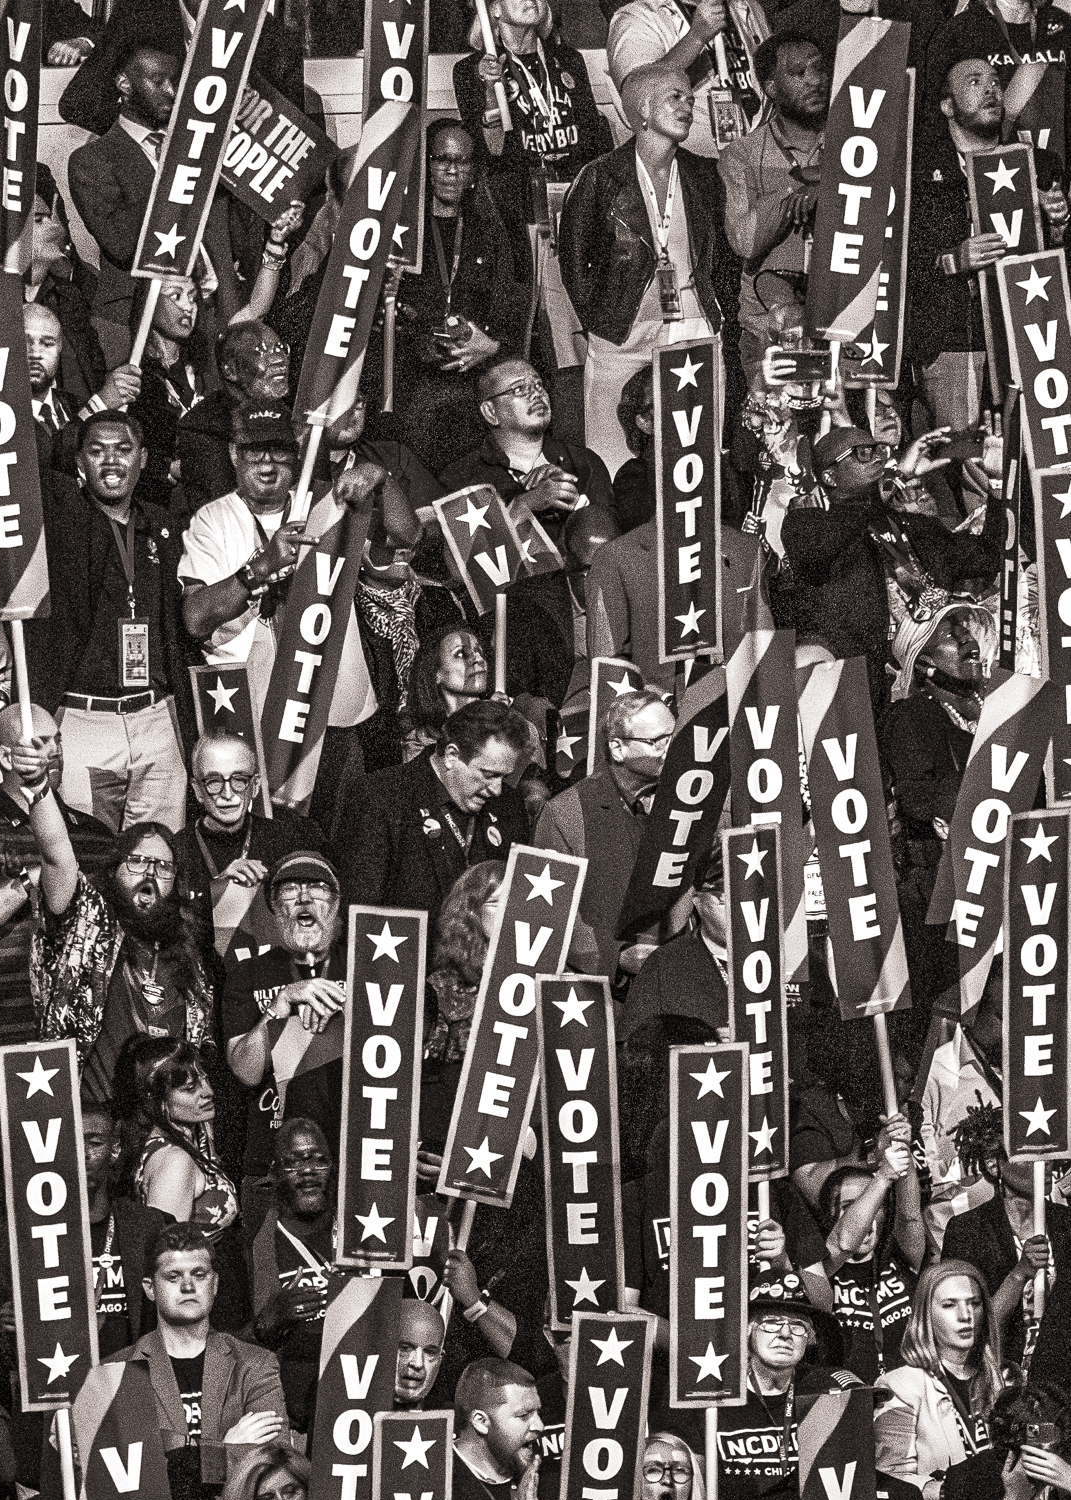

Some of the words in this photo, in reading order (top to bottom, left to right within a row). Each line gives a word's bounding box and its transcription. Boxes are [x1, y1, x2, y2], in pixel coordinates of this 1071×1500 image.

[3, 18, 31, 213] VOTE
[168, 28, 242, 205] VOTE
[223, 124, 294, 203] OPLE
[263, 113, 316, 171] THE
[829, 86, 886, 275] VOTE
[324, 167, 396, 358] VOTE
[671, 404, 704, 584] VOTE
[278, 551, 345, 742] VOTE
[653, 726, 729, 887] VOTE
[821, 733, 881, 942] VOTE
[955, 744, 1029, 949] VOTE
[478, 920, 553, 1119] VOTE
[741, 897, 774, 1095] VOTE
[1021, 882, 1058, 1076] VOTE
[360, 982, 404, 1182] VOTE
[556, 1048, 599, 1245] VOTE
[21, 1118, 72, 1322] VOTE
[690, 1120, 729, 1320] VOTE
